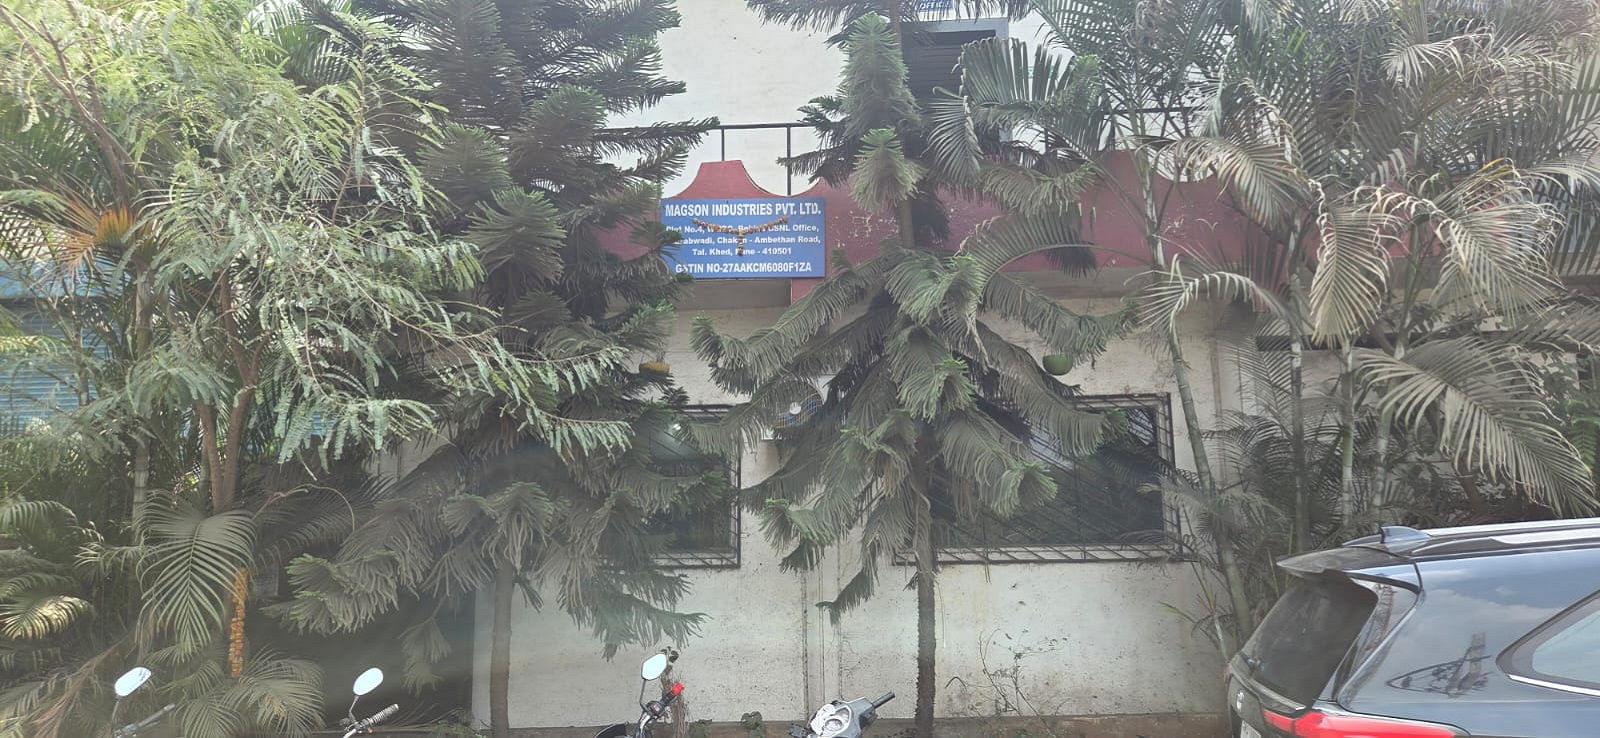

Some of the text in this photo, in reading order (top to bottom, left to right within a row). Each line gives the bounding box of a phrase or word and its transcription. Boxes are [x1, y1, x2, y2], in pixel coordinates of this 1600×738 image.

[665, 202, 821, 217] MAGSON INDUSTRIES PVT. LTD.
[684, 225, 705, 234] No.4,
[792, 224, 819, 233] Office,
[717, 236, 747, 244] Chakn
[754, 235, 796, 244] Ambethan
[798, 235, 821, 244] Road,
[709, 248, 733, 257] Khed,
[762, 247, 792, 255] 410501
[675, 263, 704, 274] GSTIN
